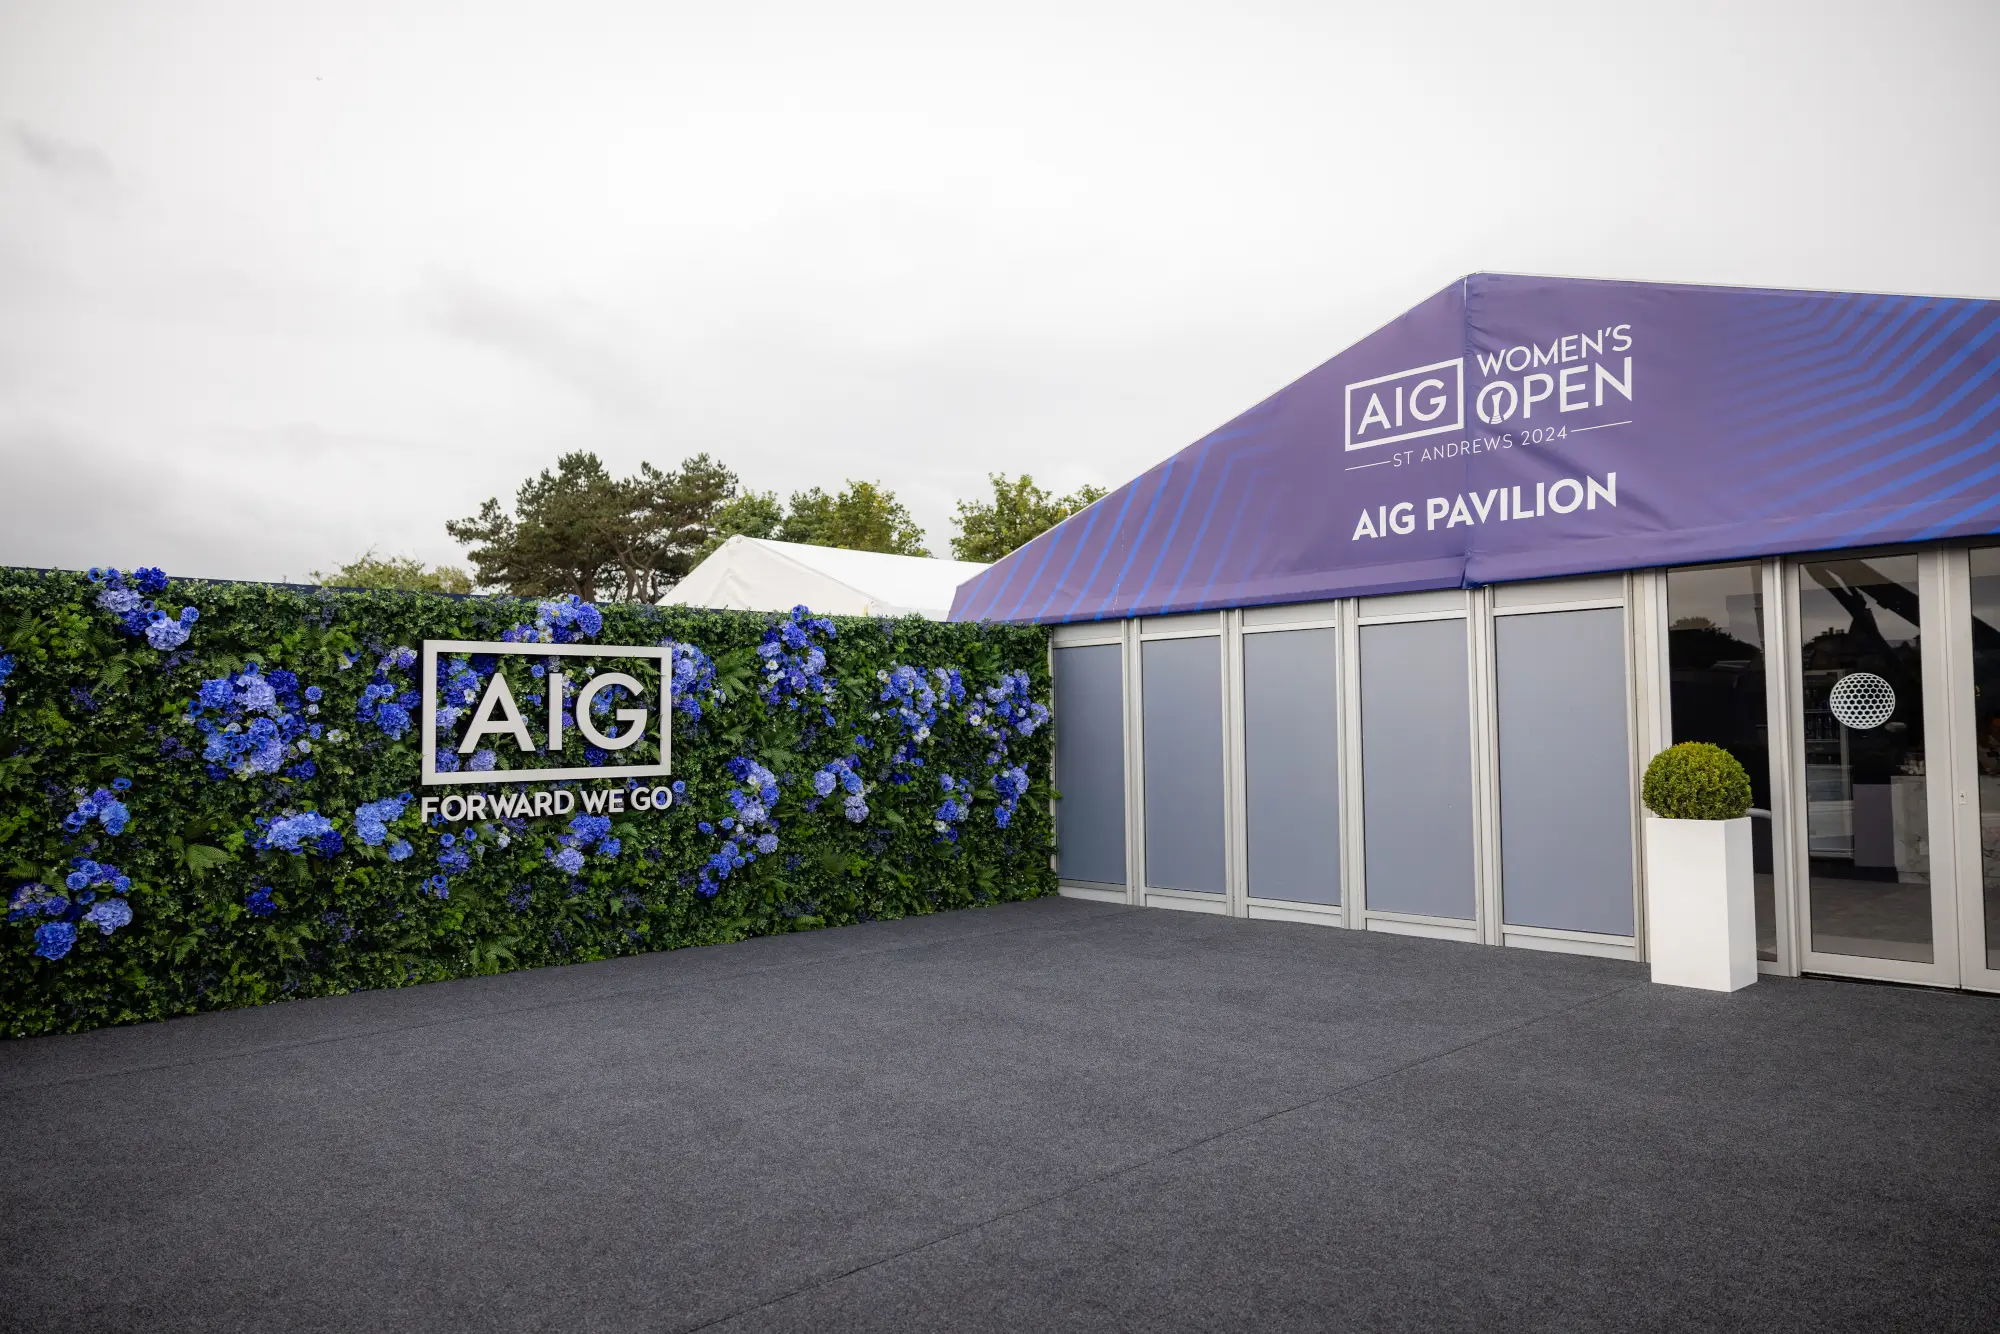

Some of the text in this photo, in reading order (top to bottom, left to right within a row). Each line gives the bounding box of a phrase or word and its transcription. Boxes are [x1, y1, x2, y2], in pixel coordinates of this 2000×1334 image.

[1357, 379, 1447, 435] AIG
[1476, 356, 1632, 425] OPEN
[1393, 425, 1568, 467] ST ANDREWS 2024
[1351, 472, 1617, 541] AIG PAVILION
[457, 672, 648, 754] AIG
[421, 786, 673, 823] FORWARD WE GO
